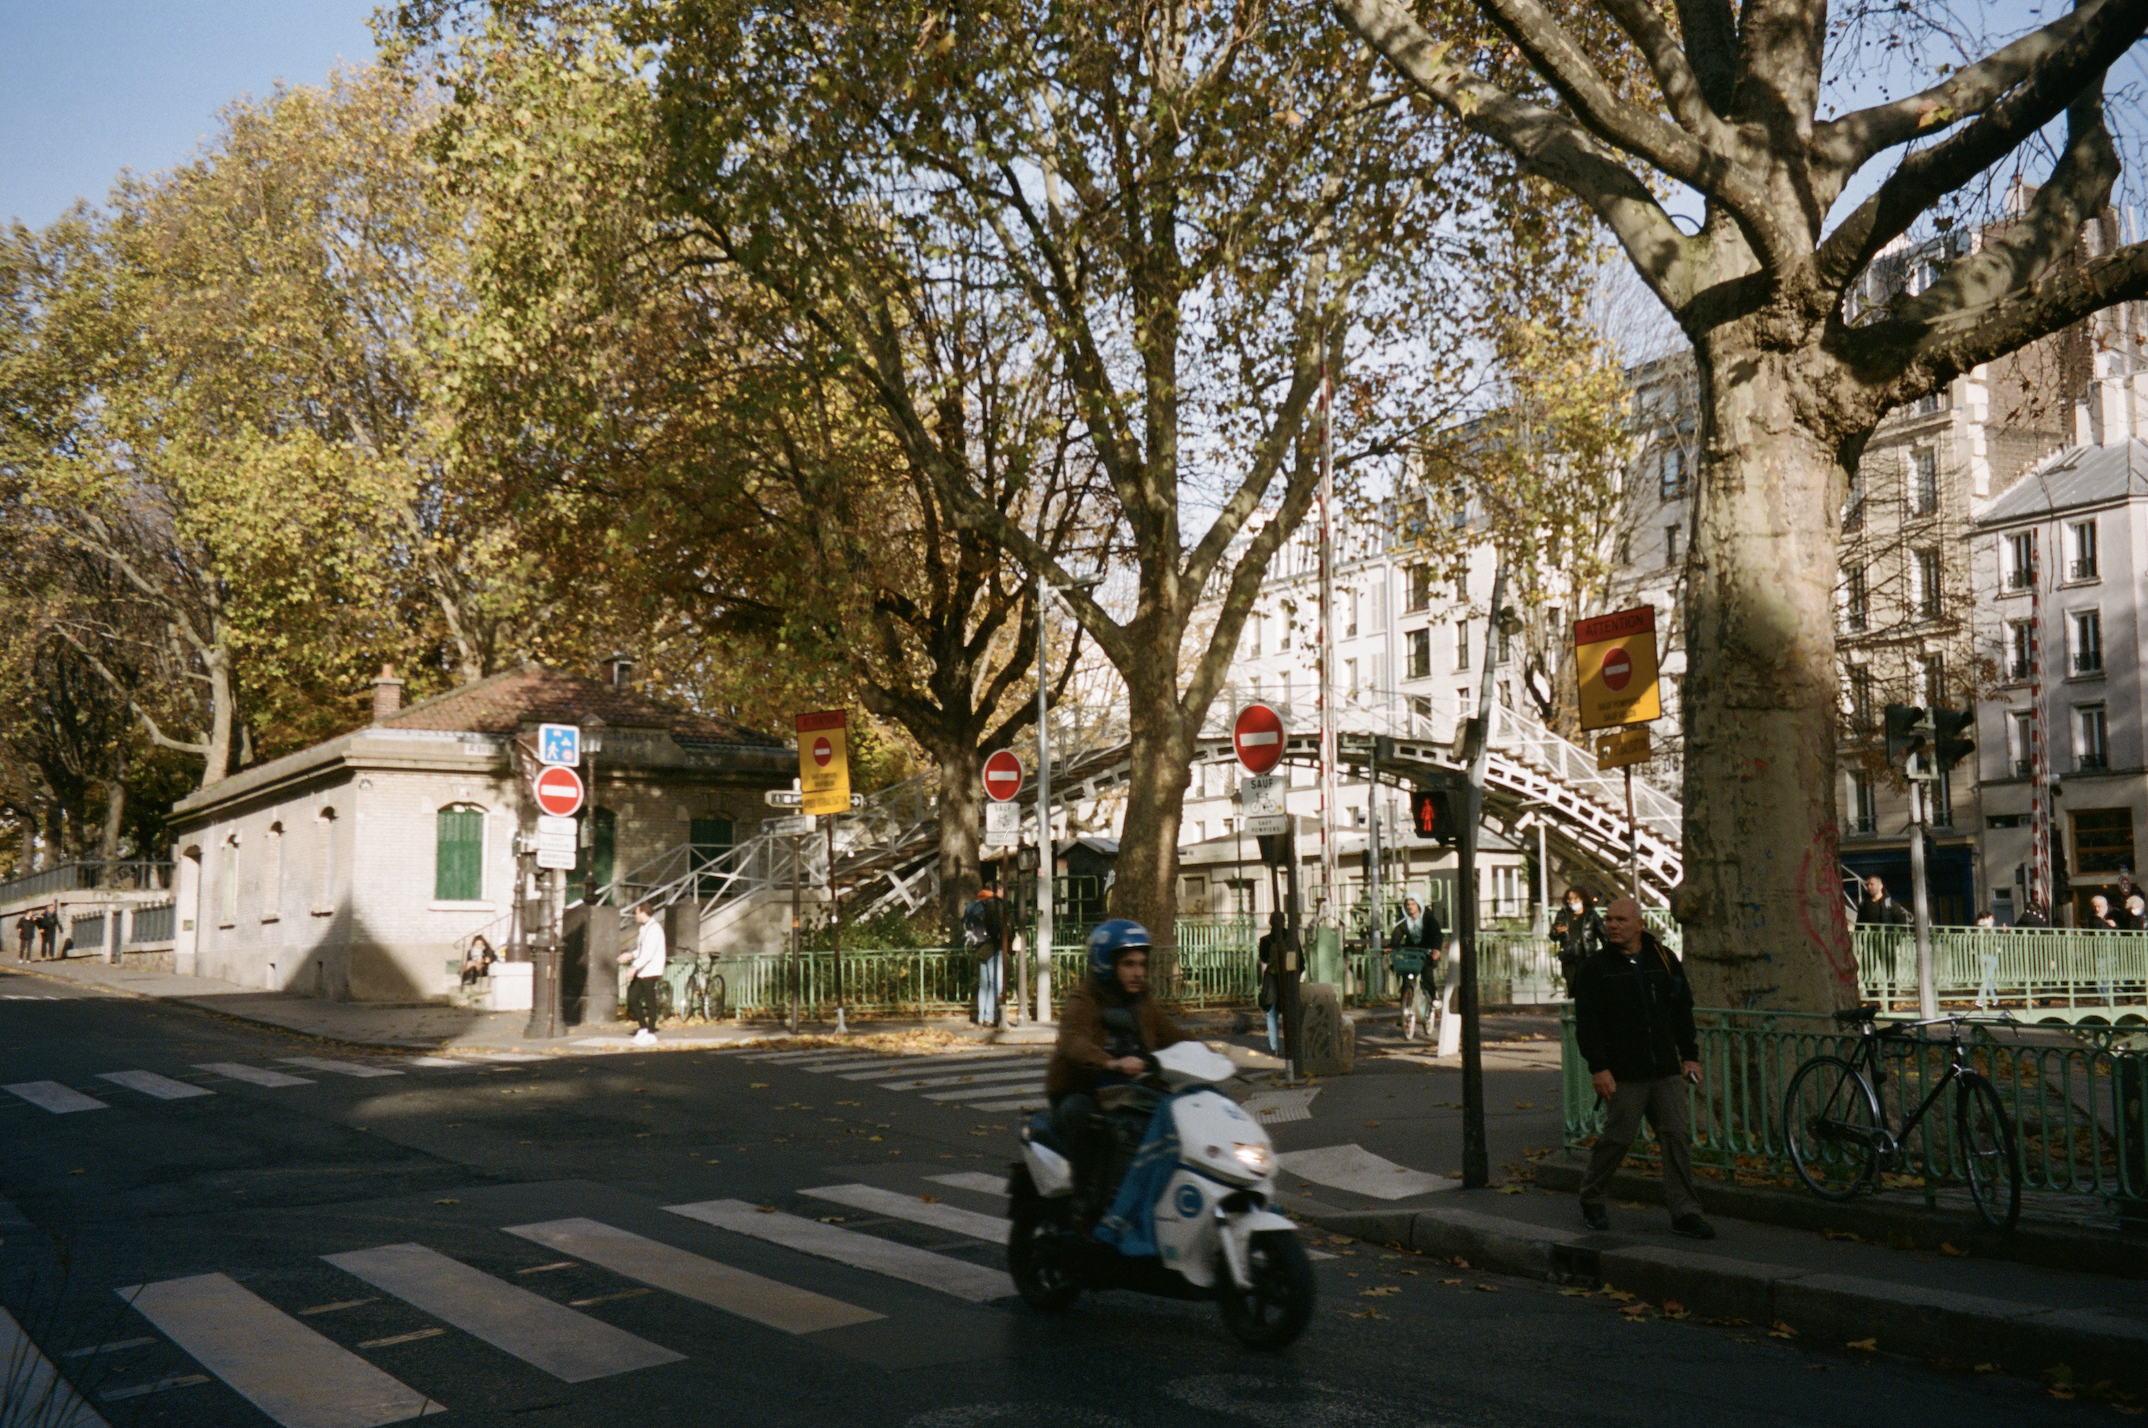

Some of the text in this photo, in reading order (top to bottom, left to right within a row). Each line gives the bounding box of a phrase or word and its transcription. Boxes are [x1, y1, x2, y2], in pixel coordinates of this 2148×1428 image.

[1585, 614, 1643, 636] ATTENTION
[1251, 778, 1273, 789] SAUF
[995, 804, 1011, 812] SAUF
